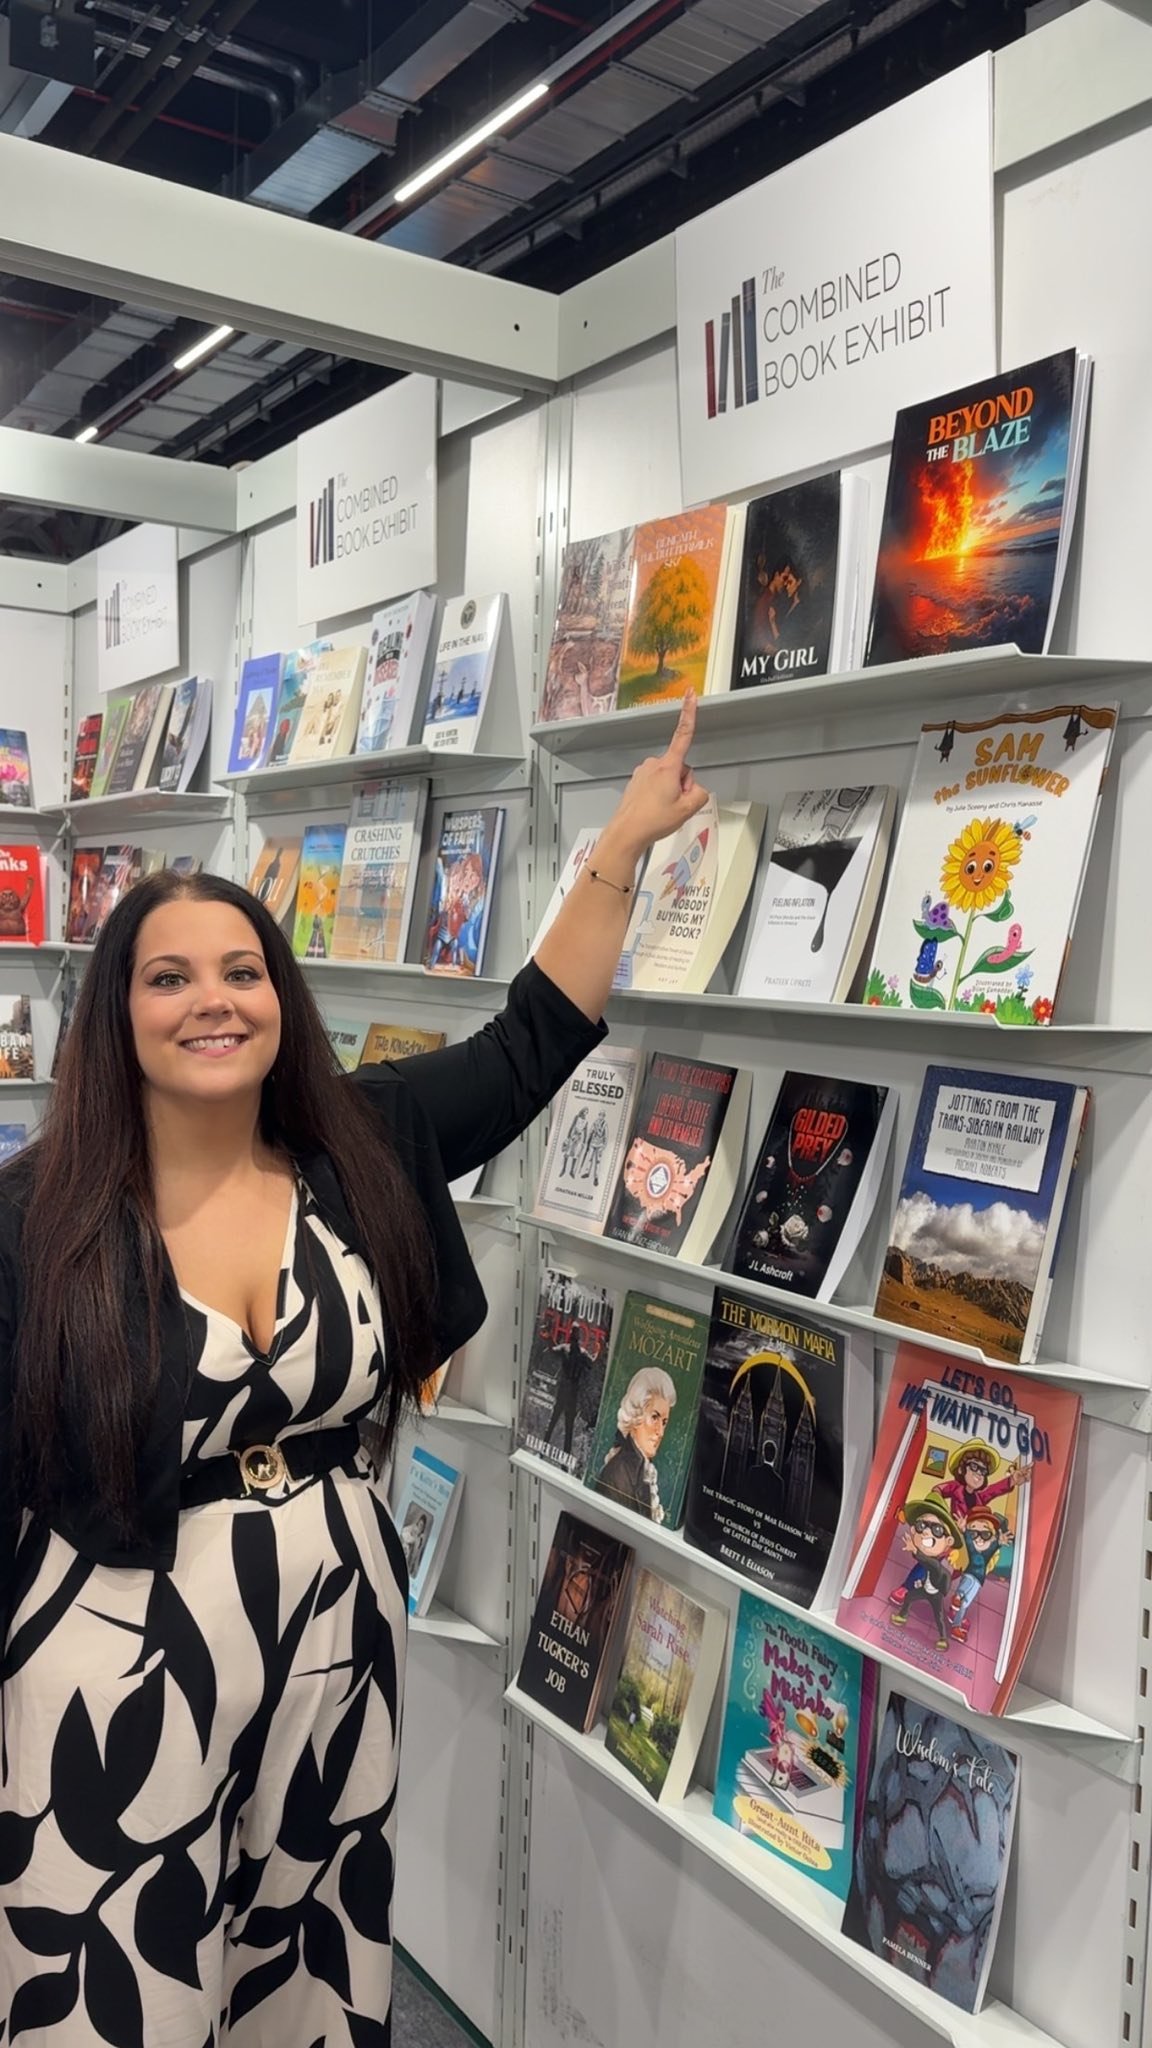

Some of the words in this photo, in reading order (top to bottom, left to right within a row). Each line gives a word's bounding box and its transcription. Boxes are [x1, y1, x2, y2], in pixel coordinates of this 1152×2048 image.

[762, 266, 785, 295] The
[763, 252, 901, 343] COMBINED
[765, 334, 837, 397] BOOK
[846, 286, 951, 366] EXHIBIT
[928, 386, 1034, 445] BEYOND
[926, 446, 949, 462] THE
[952, 416, 1032, 464] BLAZE
[336, 475, 399, 523] COMBINED
[336, 523, 370, 559] BOOK
[373, 503, 418, 545] EXHIBIT
[664, 555, 683, 570] SKY
[439, 640, 451, 653] LIFE
[452, 639, 457, 650] IN
[458, 635, 470, 648] THE
[471, 632, 486, 646] NAV
[740, 655, 770, 678] MY
[773, 646, 818, 671] GIRL
[974, 732, 1045, 767] SAM
[933, 783, 960, 806] the
[965, 764, 1070, 798] SUNFLOWER
[354, 827, 402, 843] CRASHING
[445, 814, 482, 830] WHISPERS
[351, 845, 401, 861] CRUTCHES
[442, 832, 453, 846] OF
[671, 899, 708, 912] NOBODY
[684, 885, 701, 897] WHY
[702, 886, 711, 898] IS
[656, 910, 689, 924] BUYING
[690, 914, 706, 926] MY
[669, 925, 702, 940] BOOK?
[1, 1033, 26, 1047] BAN
[571, 1079, 624, 1100] BLESSED
[586, 1068, 616, 1082] TRULY
[653, 1093, 685, 1121] LIBERAL
[684, 1099, 711, 1127] STATE
[794, 1108, 847, 1139] GILDED
[948, 1094, 992, 1116] JOTTINGS
[994, 1099, 1020, 1120] FROM
[1022, 1103, 1041, 1123] THE
[647, 1115, 664, 1137] AND
[938, 1112, 1004, 1139] TRANS-SIBERIAN
[1005, 1122, 1045, 1146] RAILWAY
[794, 1132, 834, 1163] PREY
[749, 1259, 754, 1270] J
[755, 1261, 760, 1273] L
[760, 1263, 793, 1282] Ashcroft
[721, 1301, 747, 1325] THE
[749, 1310, 800, 1346] MORMON
[803, 1330, 836, 1361] MAFIA
[628, 1330, 698, 1371] MOZART
[940, 1366, 987, 1401] LET'S
[989, 1380, 1019, 1416] GO,
[899, 1382, 930, 1416] WE
[931, 1393, 985, 1444] WANT
[987, 1411, 1012, 1450] TO
[1017, 1421, 1053, 1466] GO!
[526, 1433, 551, 1457] KRAMER
[702, 1485, 715, 1497] THE
[715, 1492, 737, 1507] TRAGIC
[737, 1501, 755, 1515] STORY
[778, 1520, 803, 1538] ELIASON
[714, 1512, 726, 1524] THE
[726, 1518, 751, 1536] CHURCH
[759, 1535, 775, 1549] JESUS
[775, 1543, 798, 1560] CHRIST
[731, 1529, 752, 1546] LATTER
[763, 1545, 784, 1562] SAINTS
[720, 1543, 741, 1562] BRETT
[746, 1557, 776, 1581] ELIASON
[550, 1609, 591, 1648] ETHAN
[649, 1596, 687, 1638] Watching
[636, 1611, 664, 1645] Sarah
[666, 1631, 690, 1663] Rise
[763, 1621, 778, 1638] The
[777, 1624, 809, 1657] Tooth
[811, 1643, 838, 1678] Fairy
[537, 1630, 591, 1679] TUCKER'S
[763, 1637, 816, 1687] Makes
[818, 1672, 833, 1692] a
[544, 1667, 567, 1694] JOB
[770, 1668, 835, 1721] Mistake
[896, 1722, 959, 1778] Wisdom's
[777, 1836, 785, 1847] by
[801, 1830, 821, 1853] Rita
[882, 1936, 906, 1957] PAMELA
